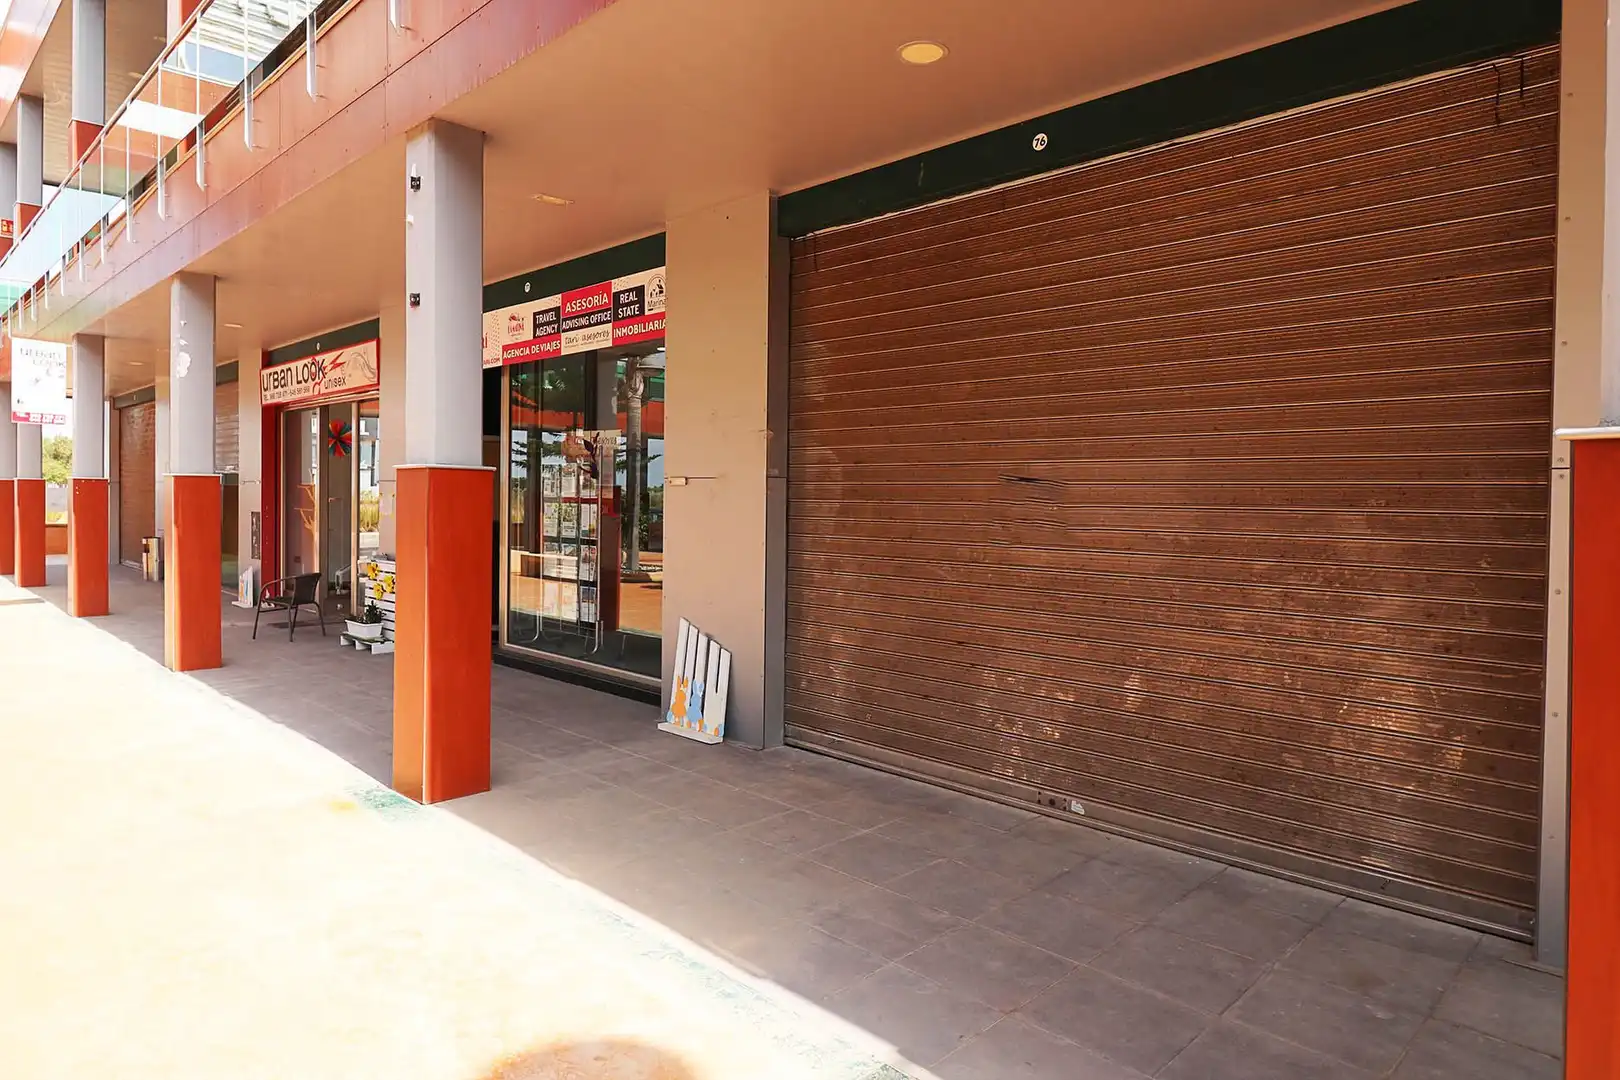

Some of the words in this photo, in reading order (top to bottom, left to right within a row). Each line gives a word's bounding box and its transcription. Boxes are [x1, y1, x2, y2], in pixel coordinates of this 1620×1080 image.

[1035, 136, 1046, 148] 76
[565, 291, 609, 313] ASESORÍA
[620, 291, 638, 304] REAL
[618, 304, 640, 318] STATE
[536, 312, 557, 324] TRAVEL
[562, 316, 589, 329] ADVISING
[590, 311, 611, 323] OFFICE
[536, 324, 558, 337] AGENCY
[503, 347, 530, 359] AGENCIA
[531, 344, 540, 354] DE
[541, 341, 560, 352] VIAJES
[324, 376, 347, 389] unisex
